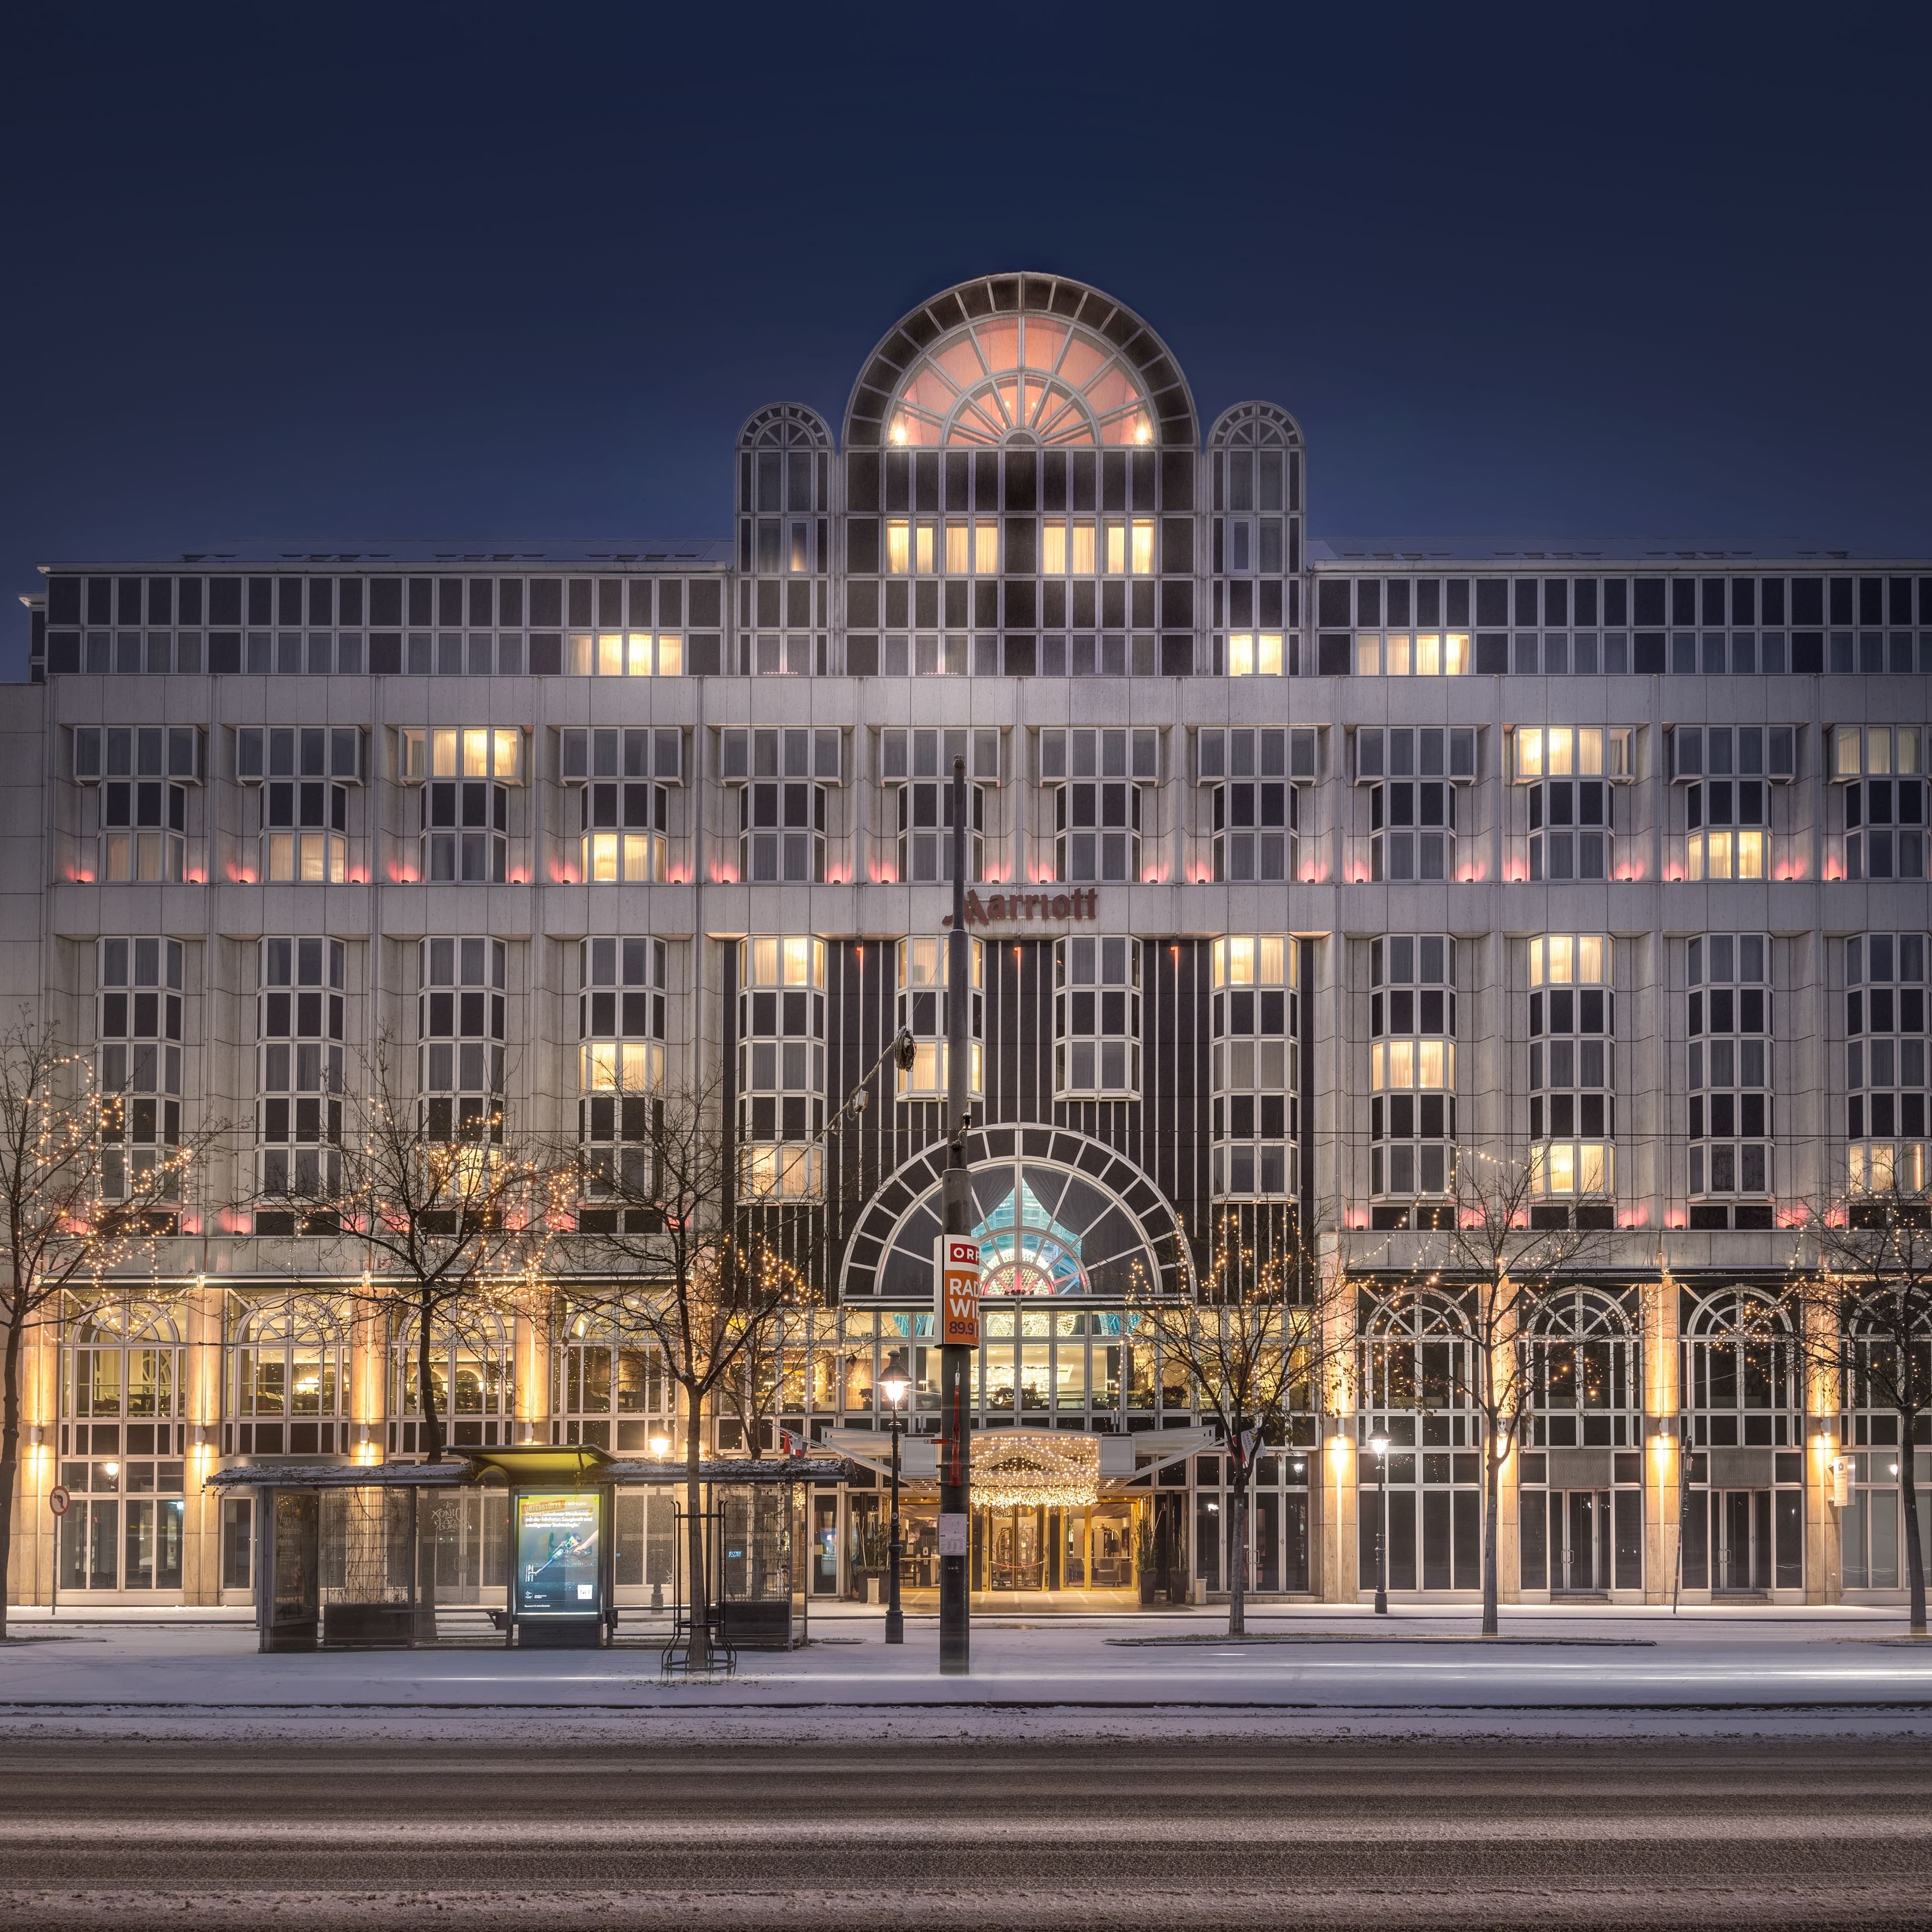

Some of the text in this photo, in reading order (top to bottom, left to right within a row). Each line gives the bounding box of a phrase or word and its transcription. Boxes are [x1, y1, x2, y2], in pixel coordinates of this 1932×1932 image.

[942, 887, 1098, 926] Marriott
[279, 1514, 298, 1525] Yoga in
[279, 1526, 302, 1537] Tropfen-
